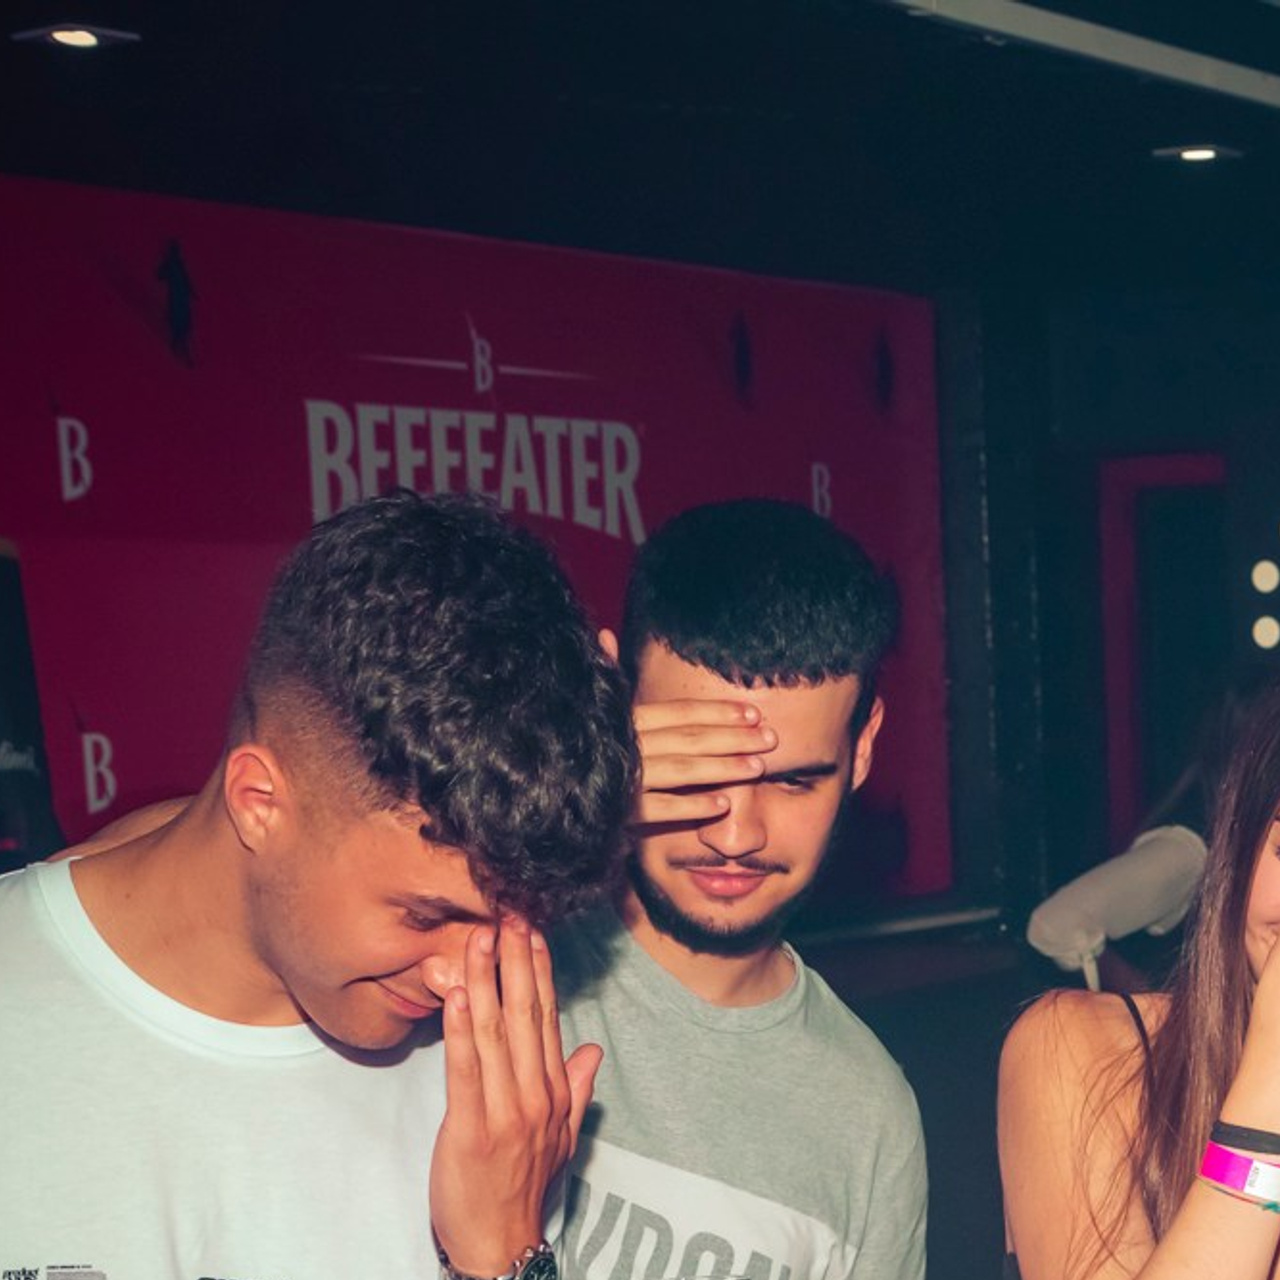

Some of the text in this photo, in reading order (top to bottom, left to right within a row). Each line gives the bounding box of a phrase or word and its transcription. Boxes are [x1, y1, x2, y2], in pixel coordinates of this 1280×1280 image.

[473, 337, 494, 392] B
[57, 417, 93, 501] B
[305, 398, 647, 547] BEEFEATER
[812, 461, 832, 518] B
[82, 731, 117, 815] B
